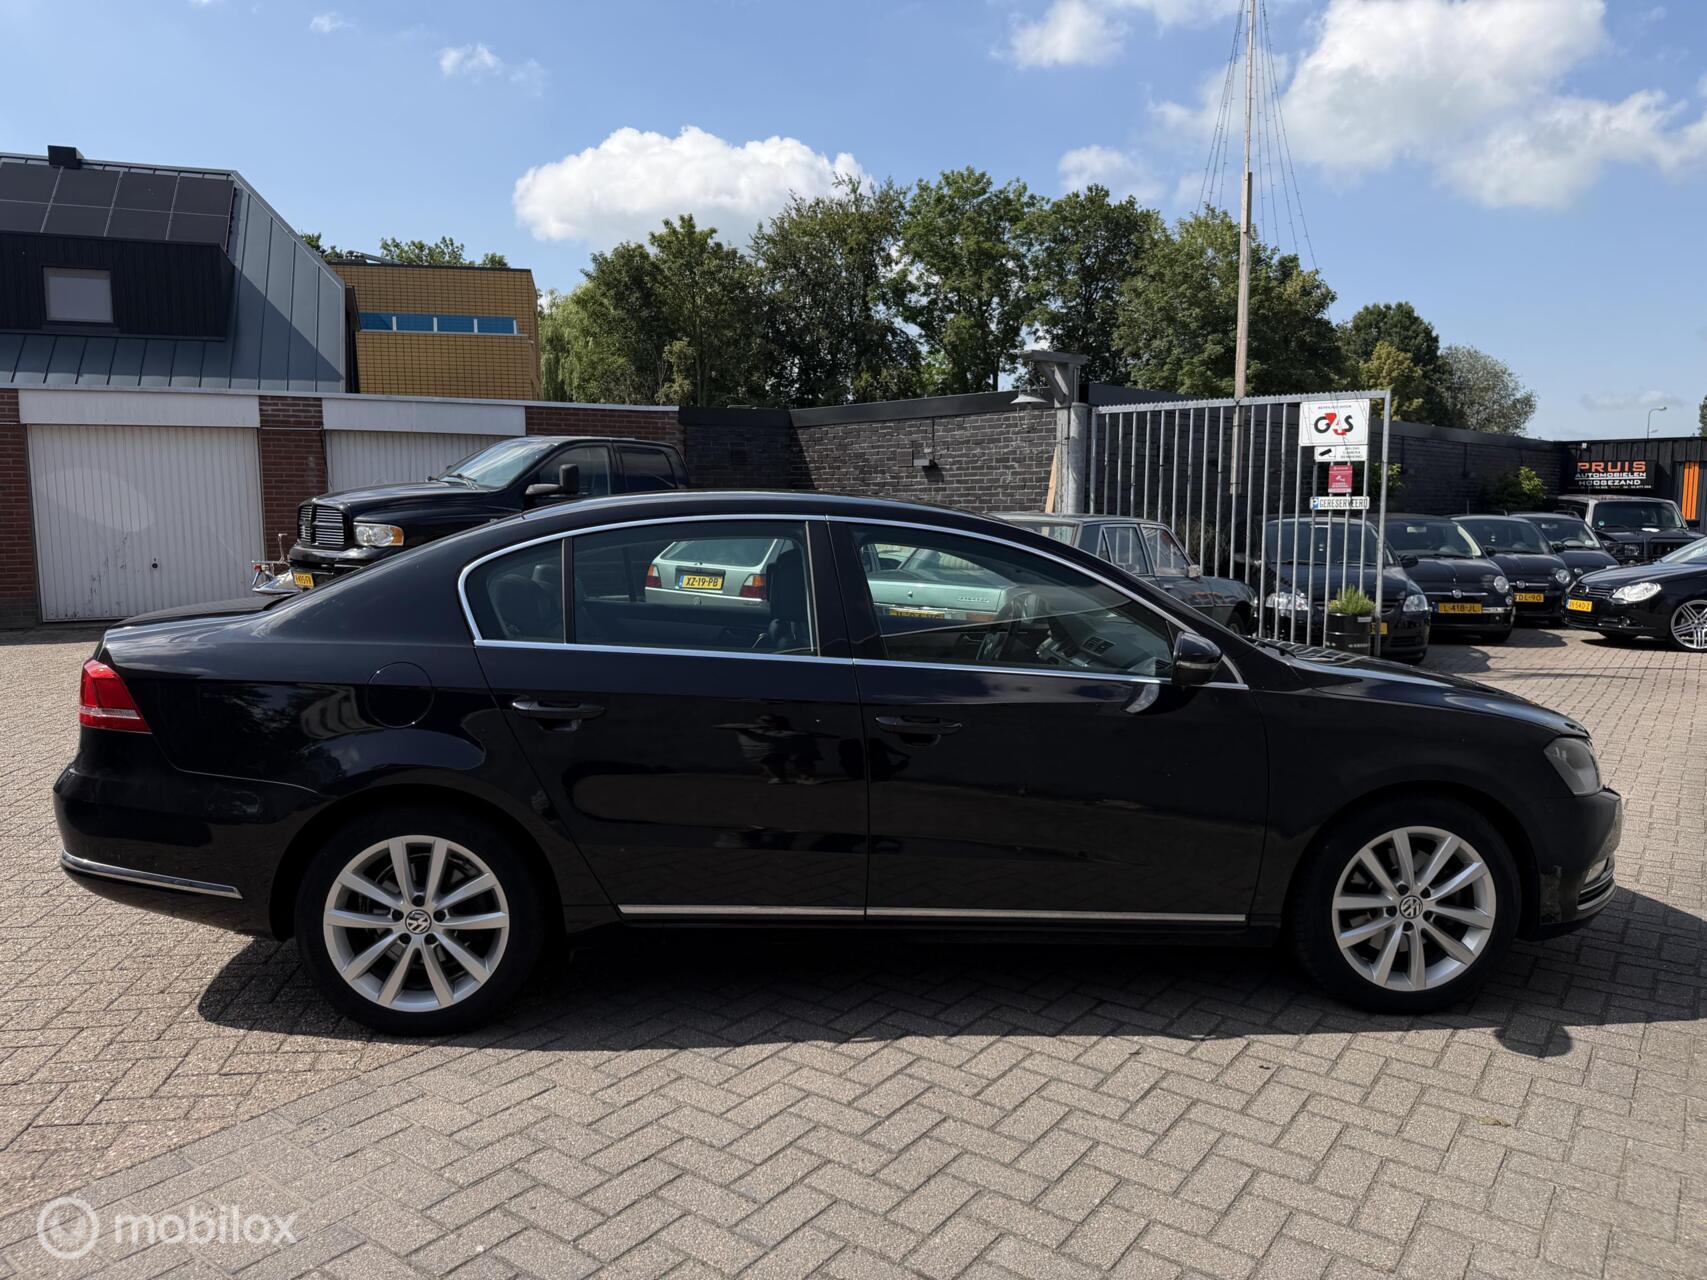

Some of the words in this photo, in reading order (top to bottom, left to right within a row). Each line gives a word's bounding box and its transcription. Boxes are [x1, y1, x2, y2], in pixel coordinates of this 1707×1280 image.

[1313, 412, 1354, 436] G4S
[1577, 461, 1646, 472] PRUIS
[685, 575, 719, 587] XZ-19-PB
